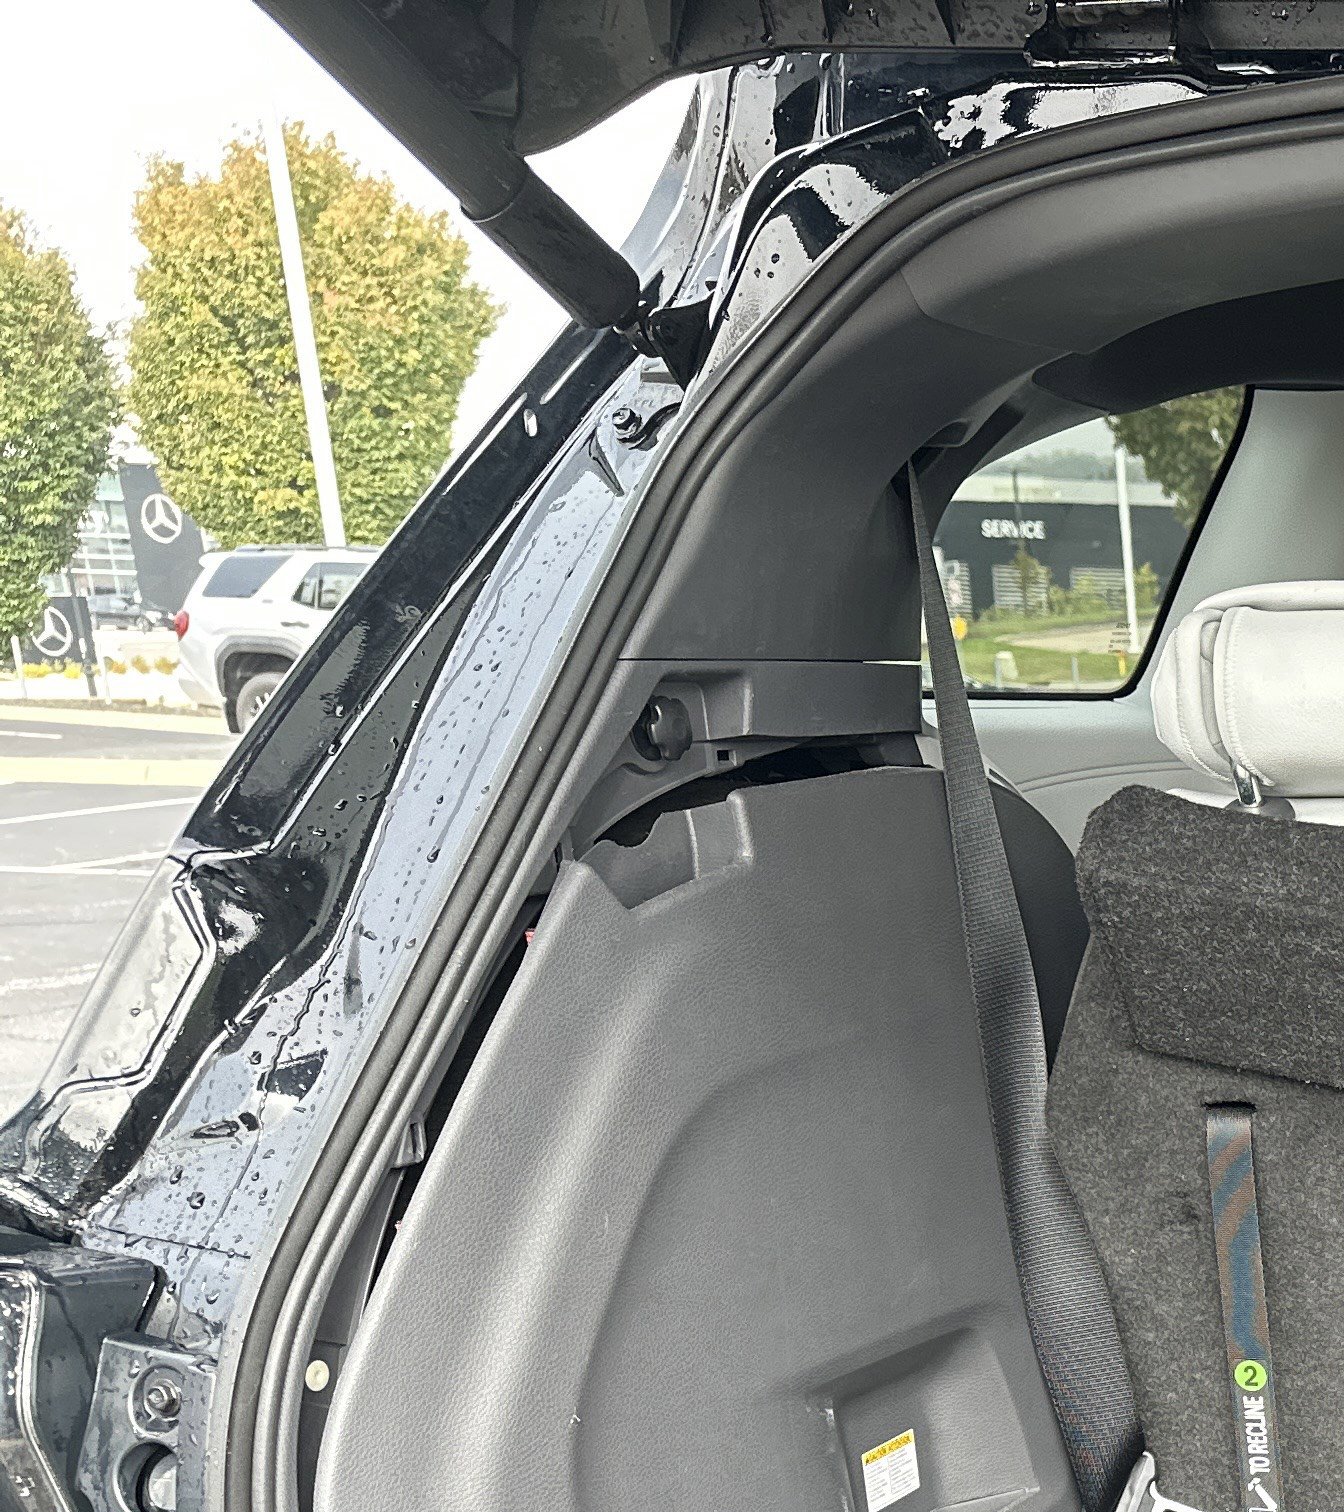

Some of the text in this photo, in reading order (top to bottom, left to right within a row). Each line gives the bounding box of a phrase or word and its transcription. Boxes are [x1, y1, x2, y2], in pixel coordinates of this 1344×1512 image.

[981, 519, 1045, 540] SERVICE
[1243, 1365, 1259, 1386] 2
[1243, 1395, 1270, 1475] TO RECLINE
